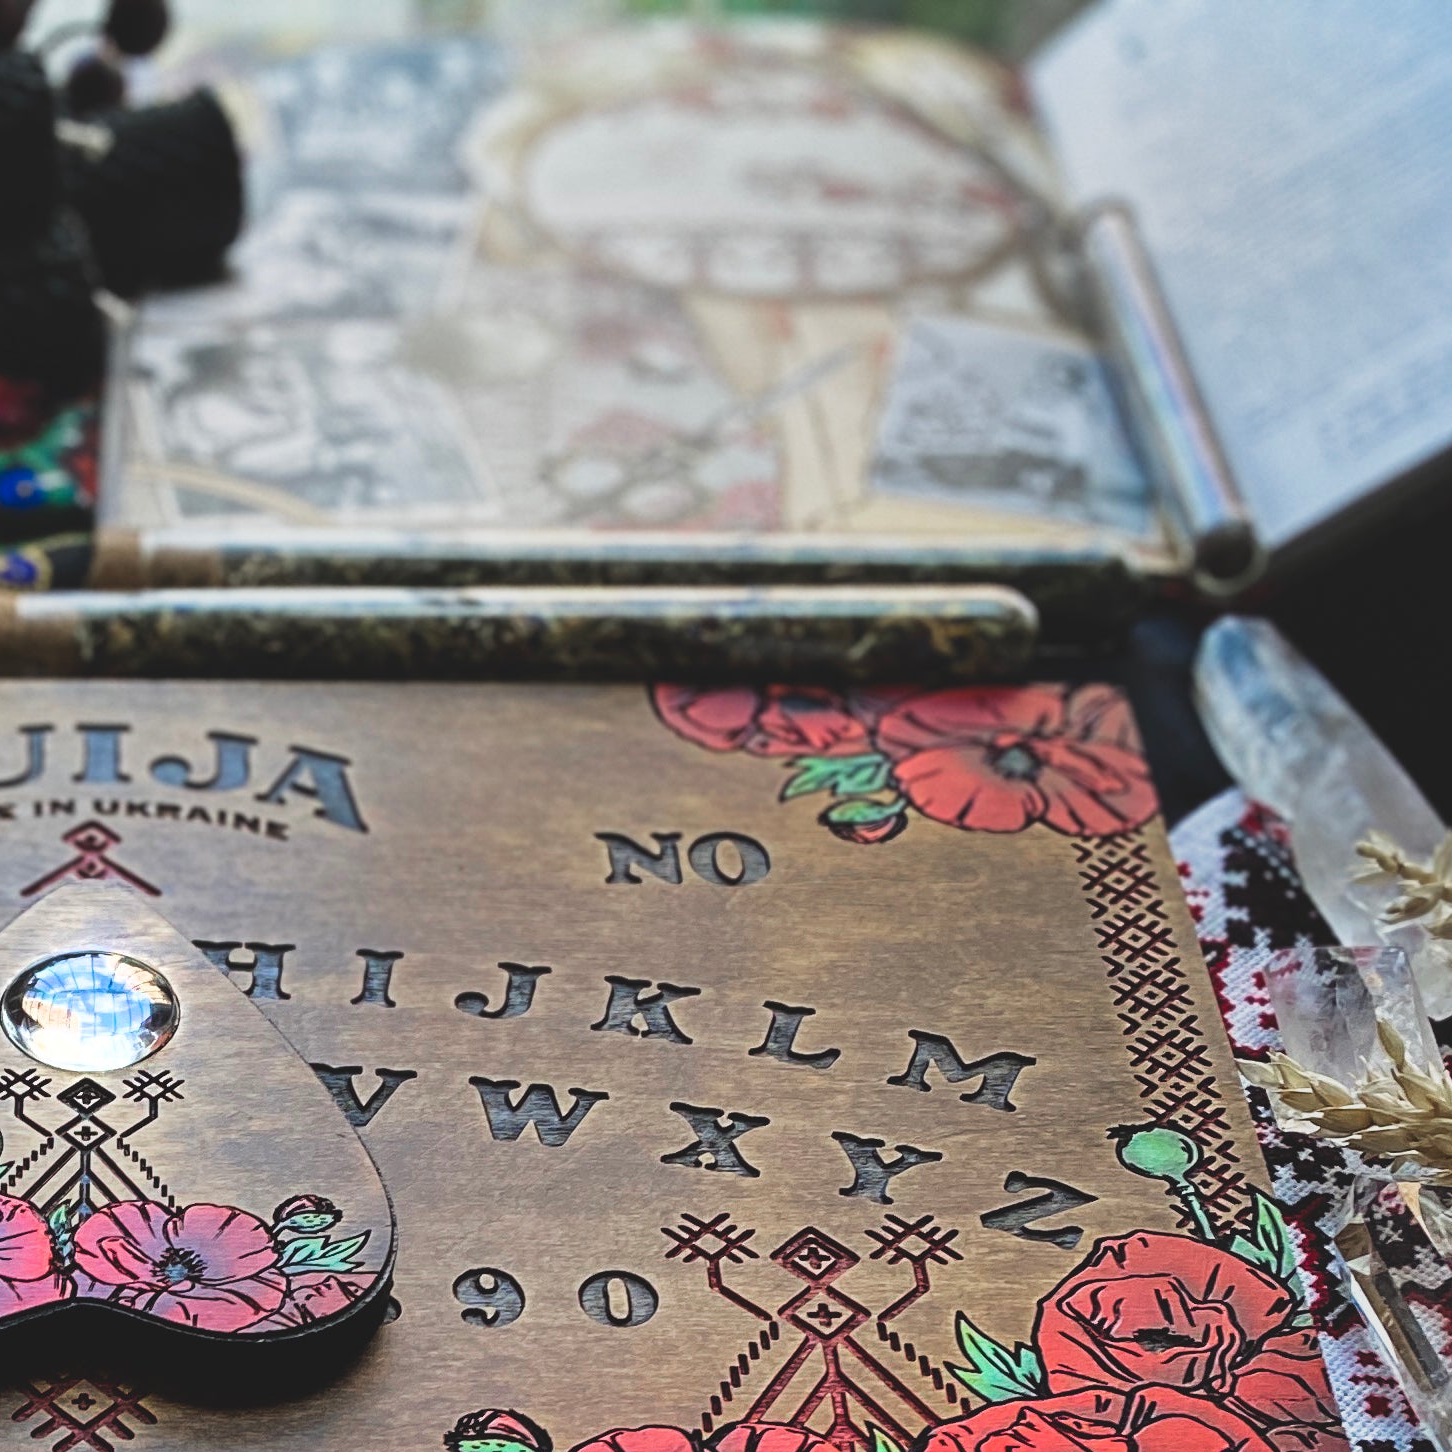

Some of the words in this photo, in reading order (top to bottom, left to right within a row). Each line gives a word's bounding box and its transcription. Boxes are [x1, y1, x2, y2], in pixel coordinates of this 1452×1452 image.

[32, 799, 76, 818] IN
[93, 799, 291, 842] UKRAINE
[594, 830, 772, 888] NO
